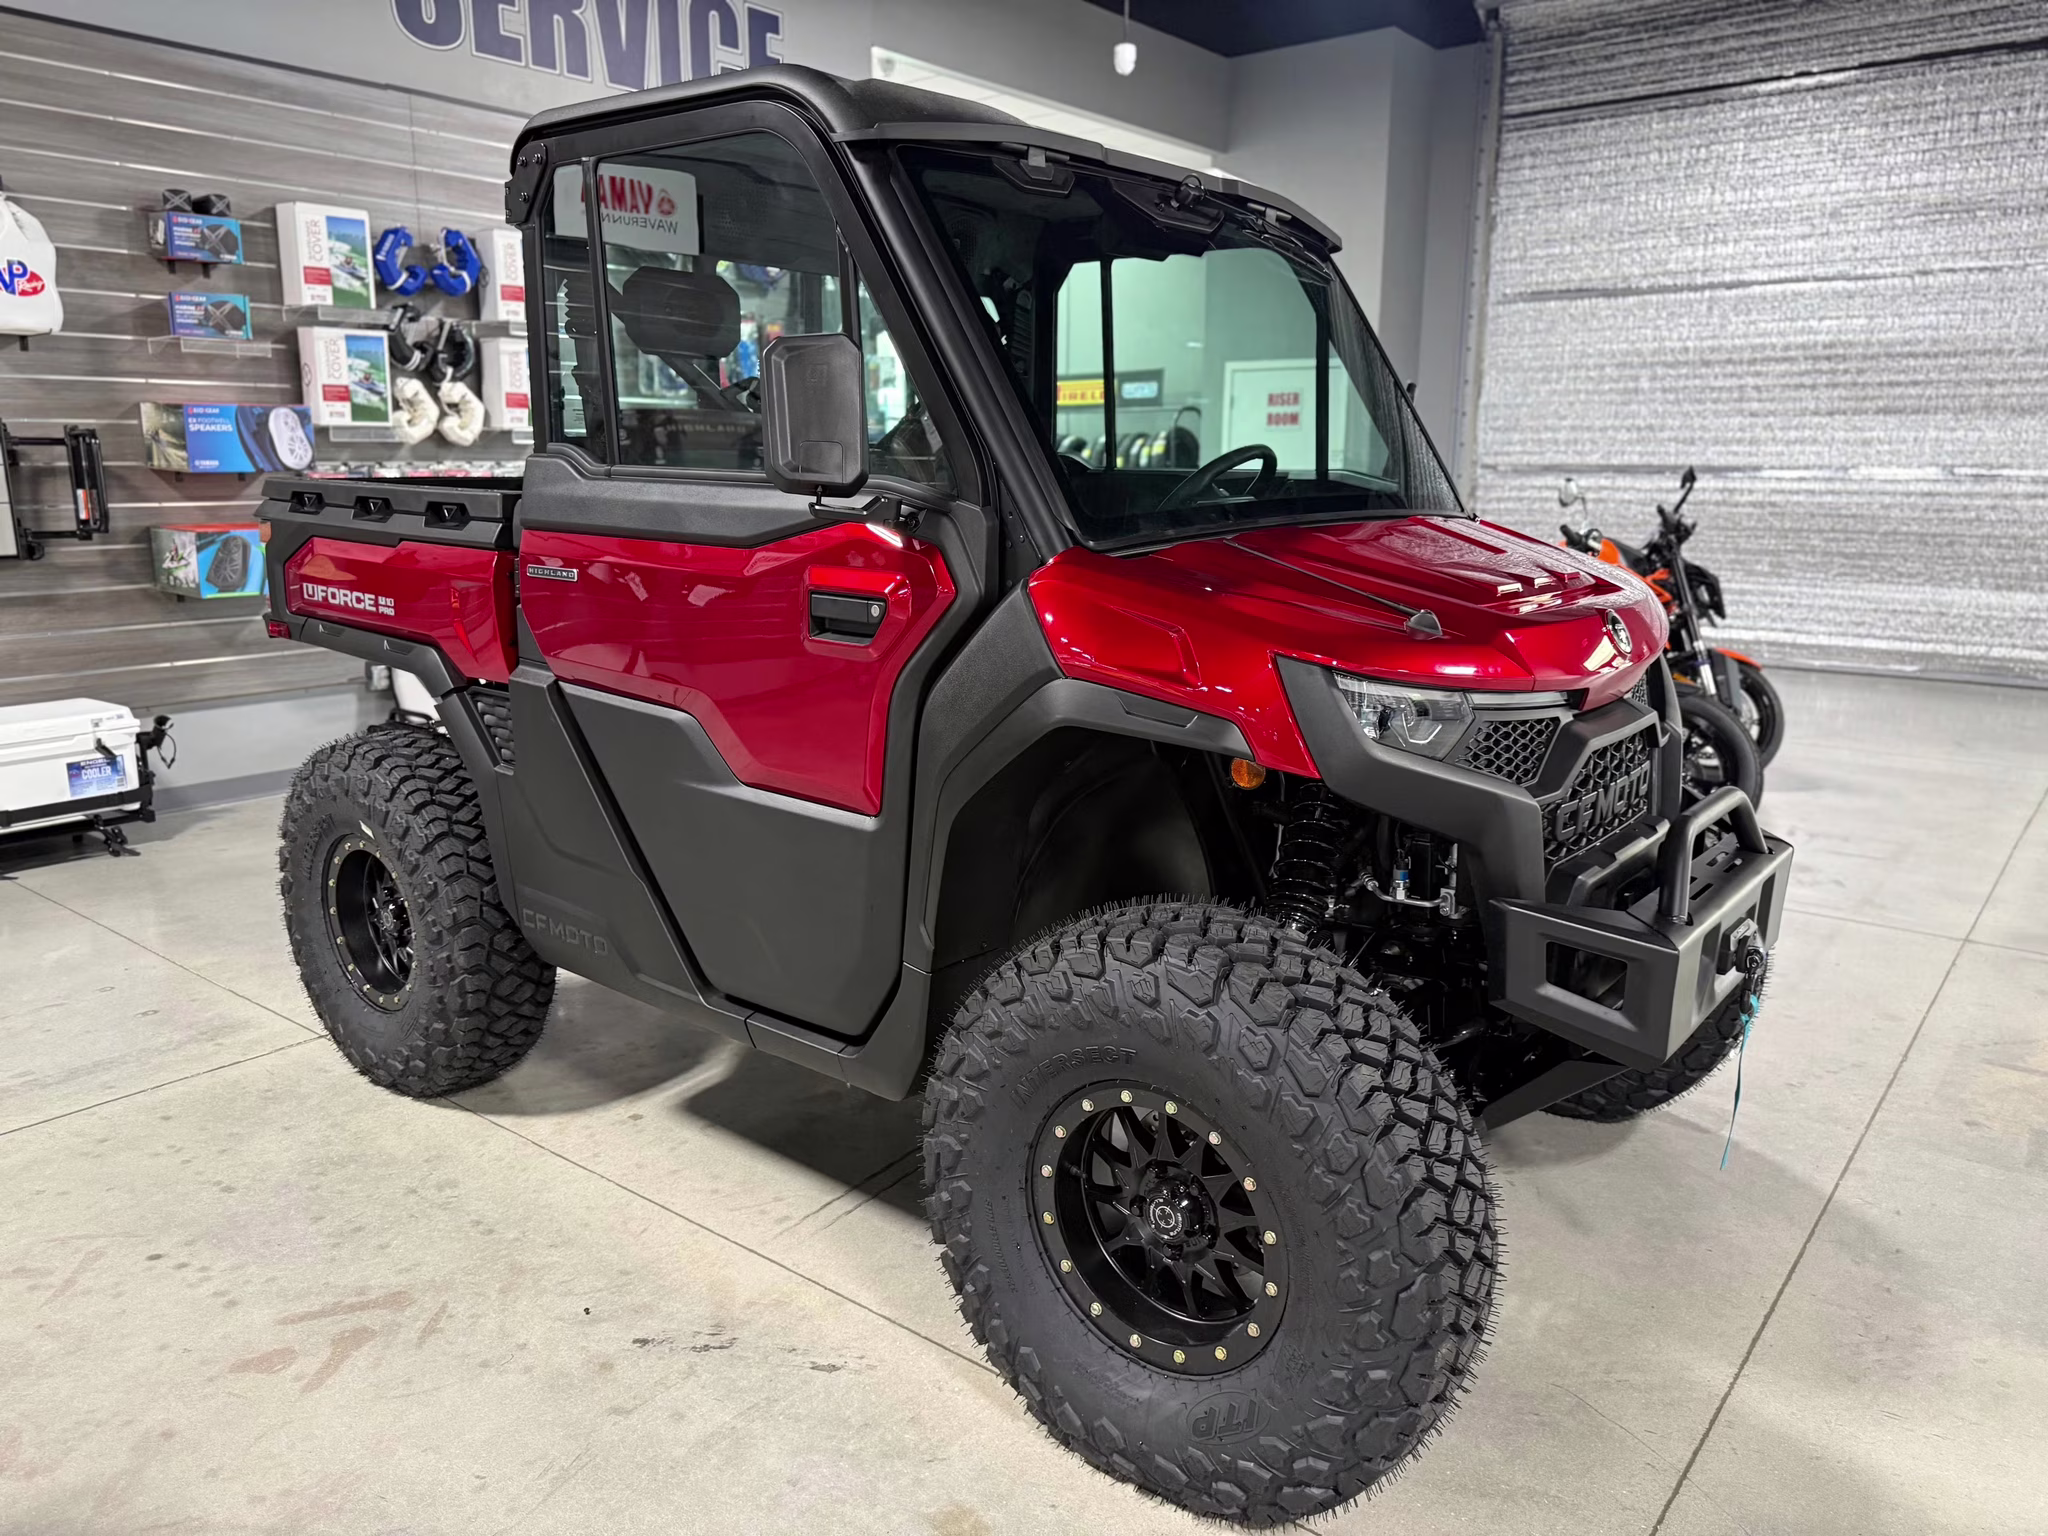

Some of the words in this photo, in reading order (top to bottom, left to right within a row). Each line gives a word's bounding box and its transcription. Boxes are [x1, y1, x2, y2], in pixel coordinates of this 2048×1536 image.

[310, 219, 324, 262] COVER
[329, 338, 343, 380] COVER
[1268, 392, 1299, 407] RISER
[189, 424, 233, 432] SPEAKERS
[1267, 412, 1299, 426] ROOM
[529, 567, 574, 578] HIGHLAND
[379, 605, 395, 616] PRO
[82, 766, 112, 780] COOLER
[1556, 760, 1650, 841] CFMOTO
[522, 907, 608, 957] CFMOTO
[1010, 1045, 1137, 1109] INTERSECT
[1192, 1399, 1259, 1440] ITP
